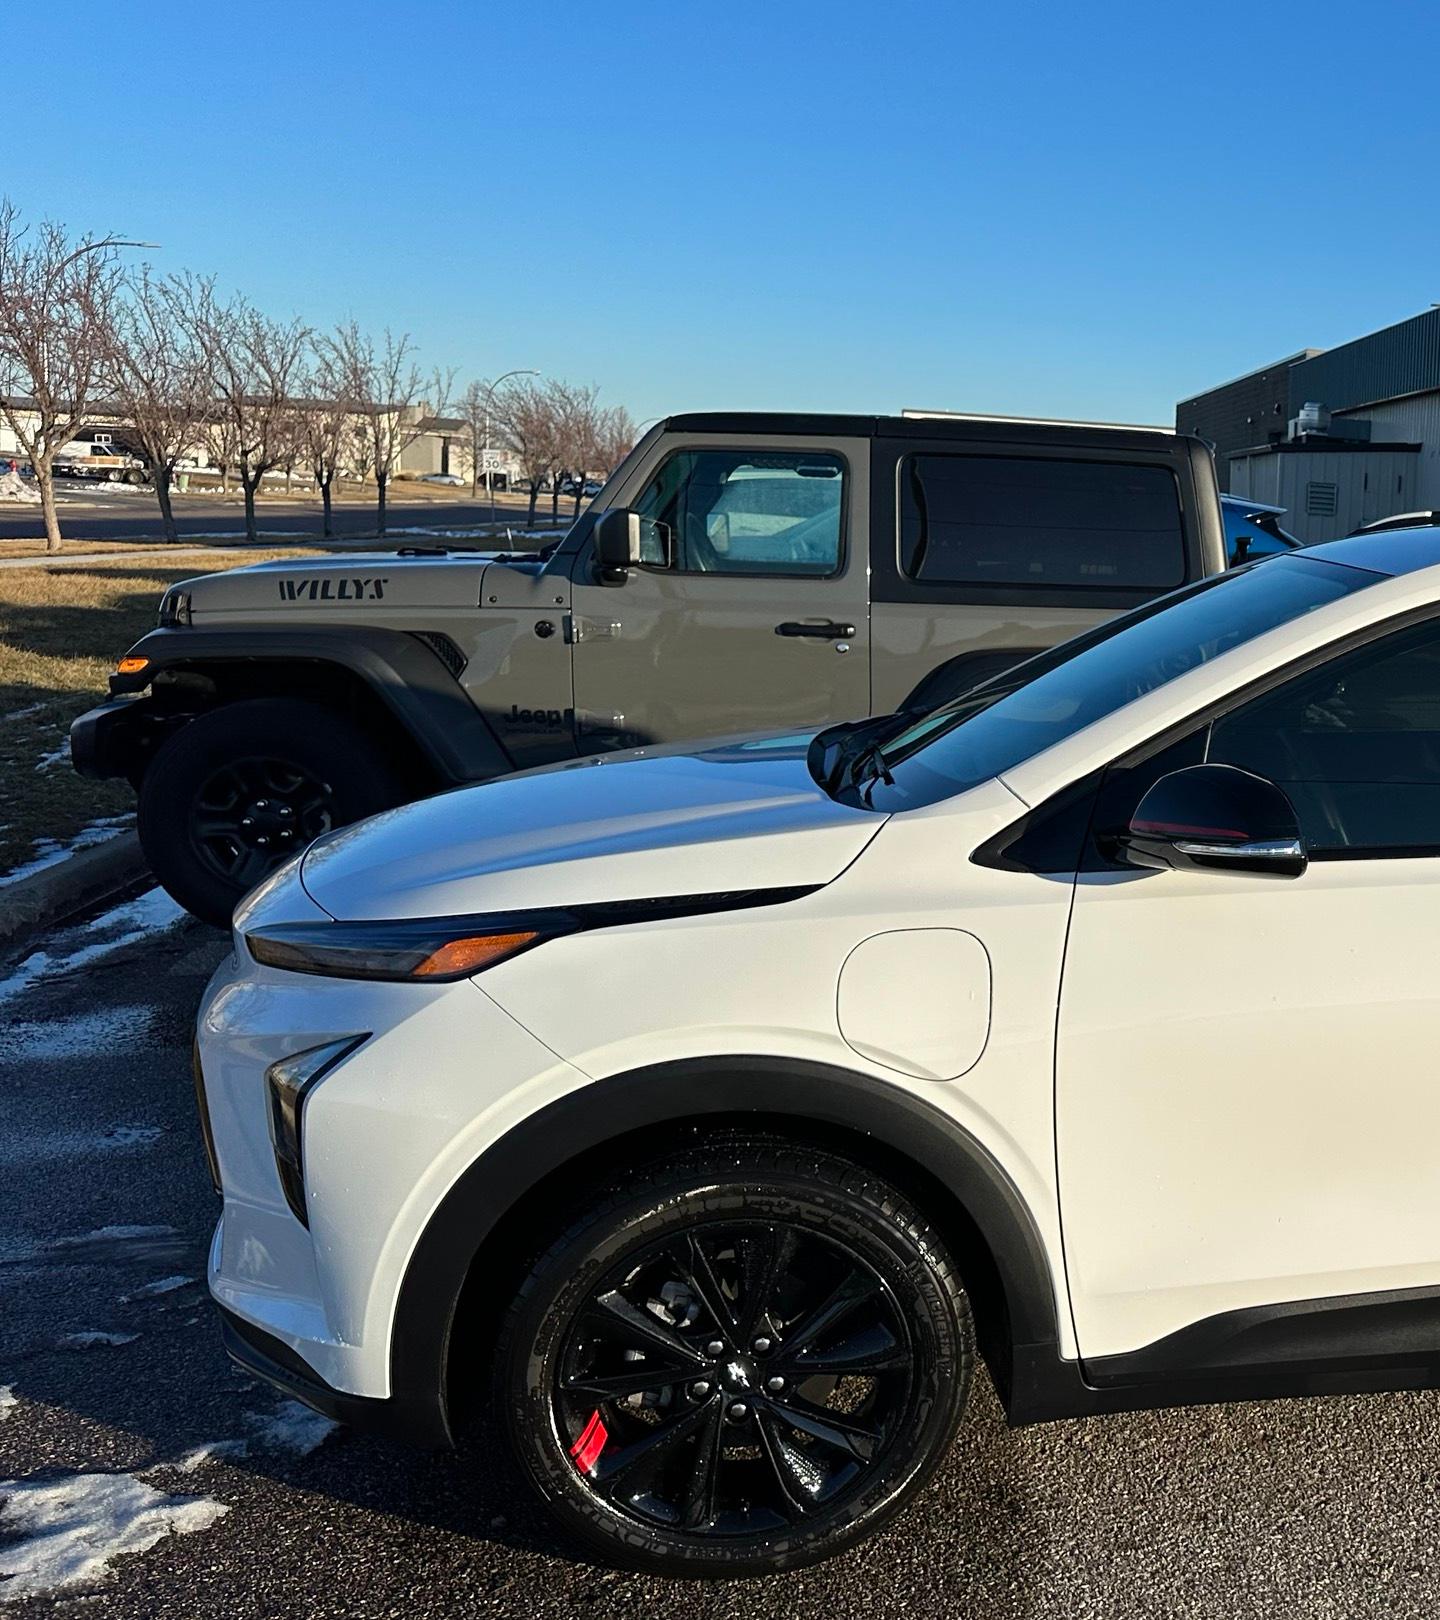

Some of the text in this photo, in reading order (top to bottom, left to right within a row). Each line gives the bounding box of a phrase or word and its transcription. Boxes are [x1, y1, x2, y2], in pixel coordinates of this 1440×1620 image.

[485, 459, 500, 469] 30
[279, 579, 389, 600] WILLYS
[504, 704, 561, 727] Jeep
